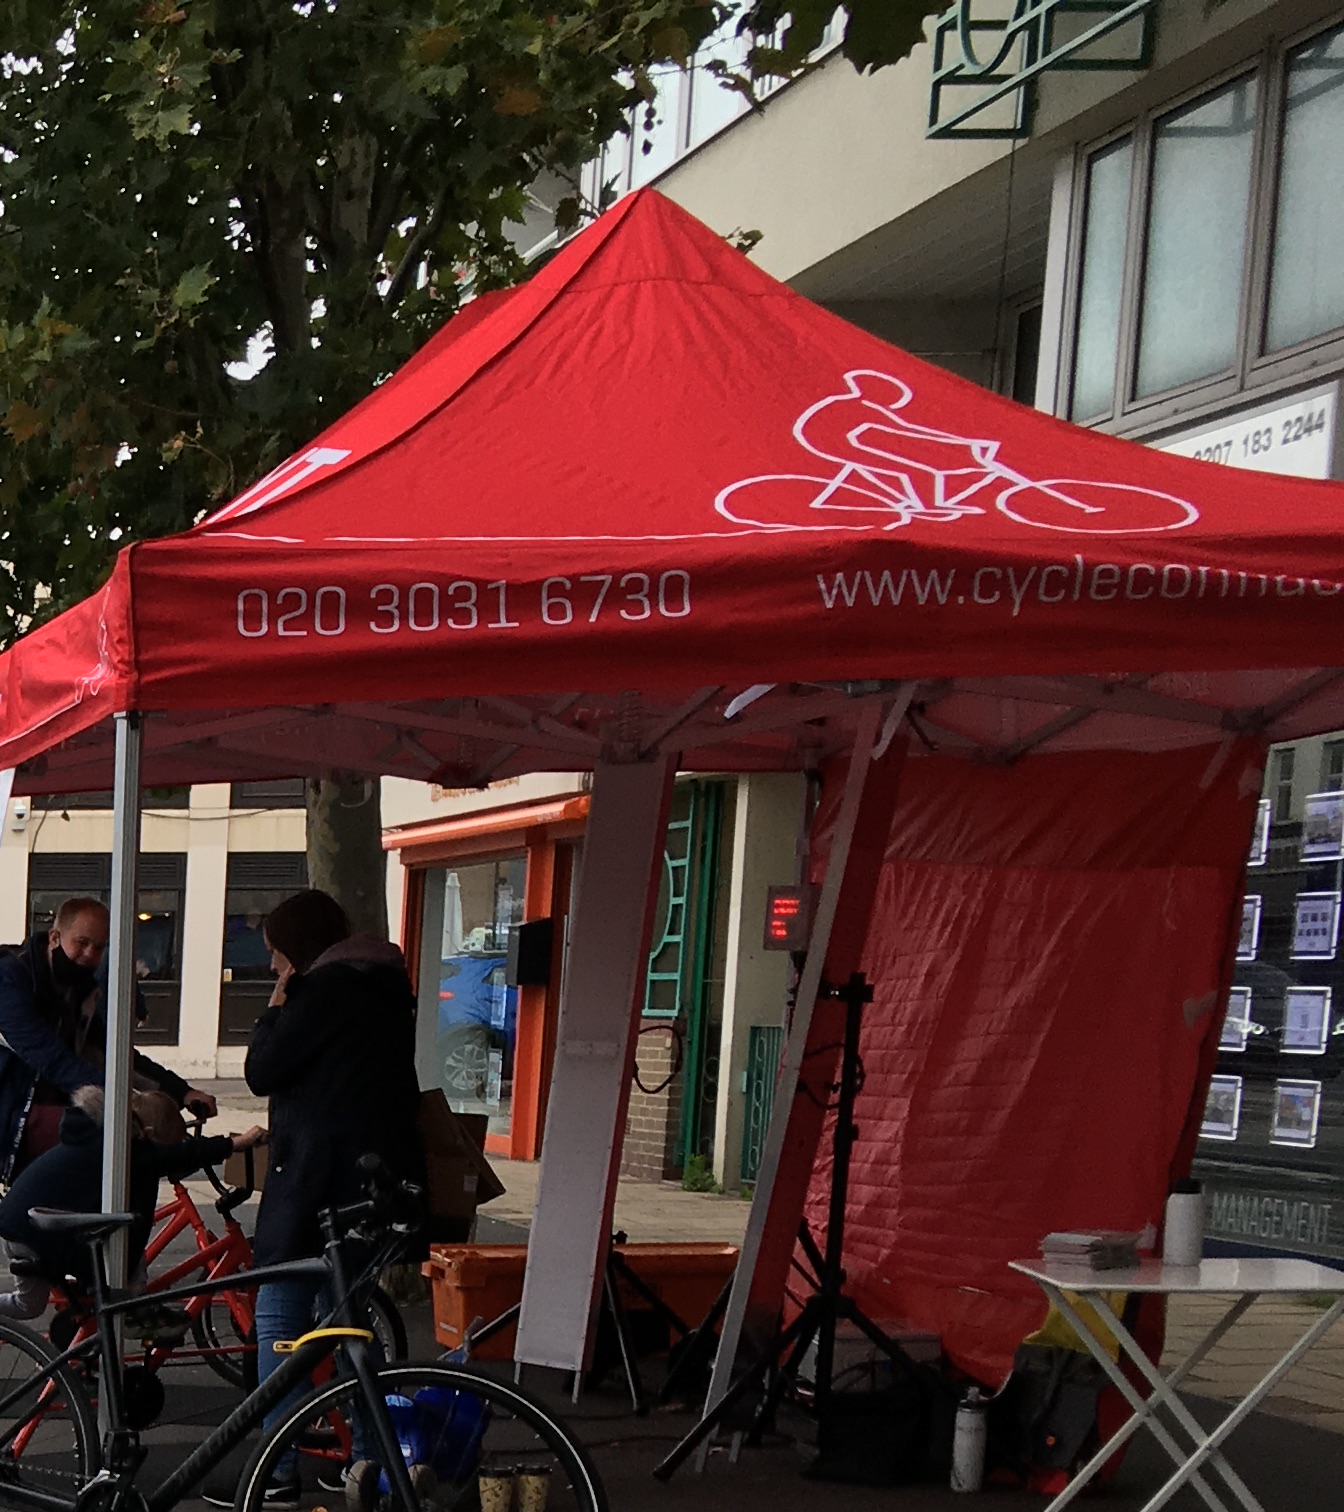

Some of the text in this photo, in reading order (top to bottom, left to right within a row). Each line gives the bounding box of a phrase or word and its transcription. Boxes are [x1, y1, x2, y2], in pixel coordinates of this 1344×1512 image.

[1243, 426, 1274, 458] 183
[1281, 408, 1326, 446] 2244
[236, 569, 693, 638] 020 3031 6730
[1211, 1192, 1332, 1246] MANAGEMENT
